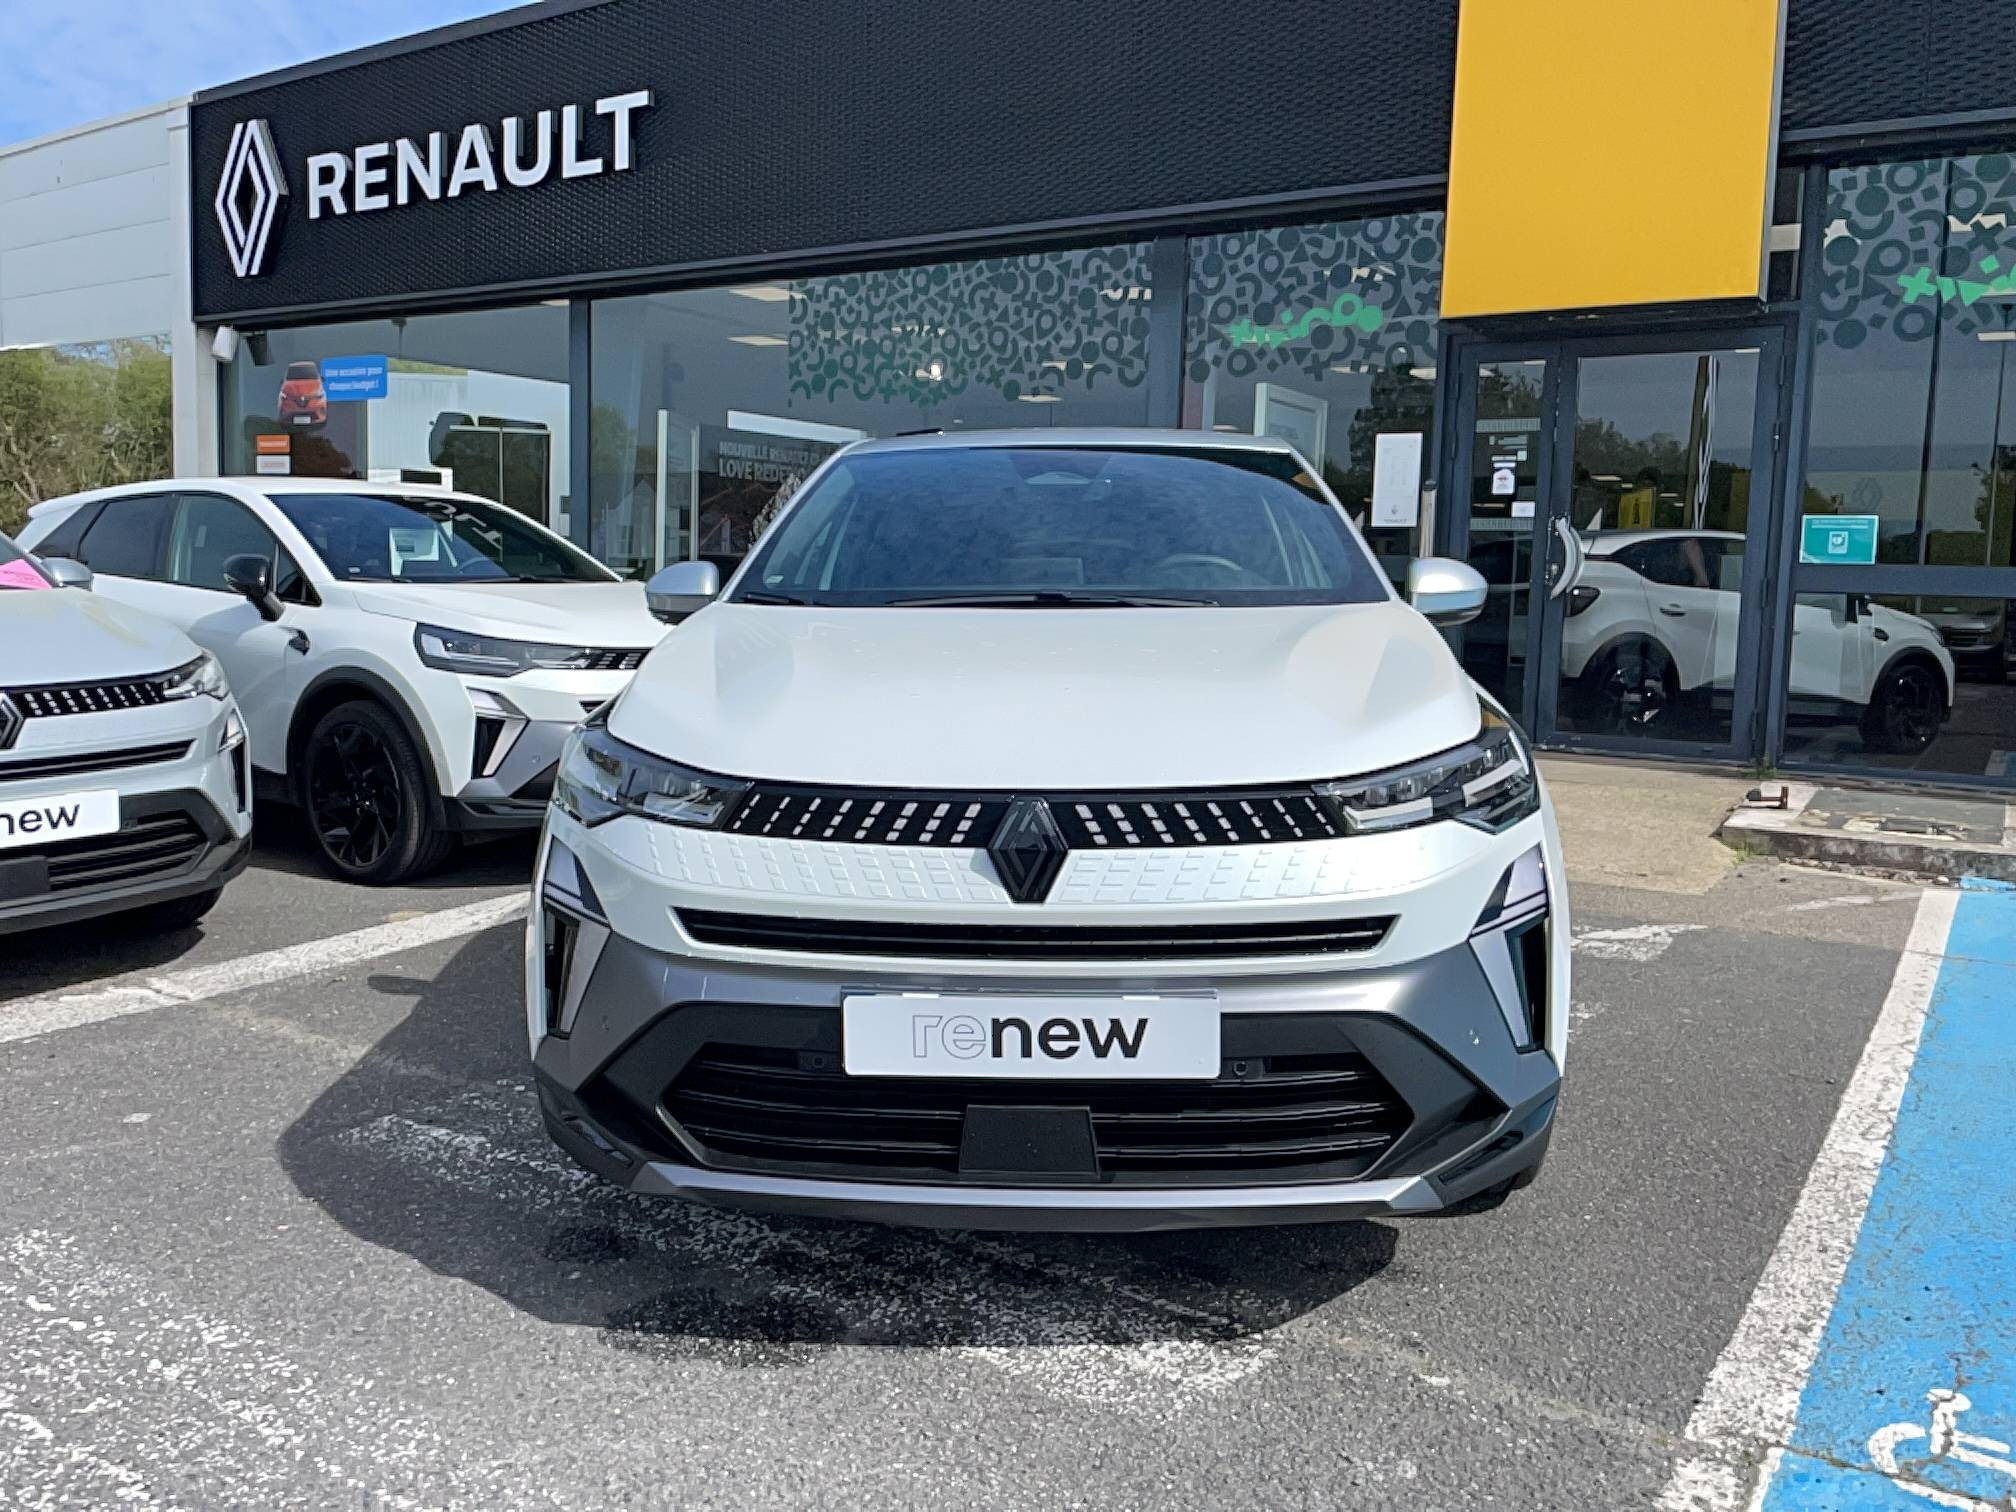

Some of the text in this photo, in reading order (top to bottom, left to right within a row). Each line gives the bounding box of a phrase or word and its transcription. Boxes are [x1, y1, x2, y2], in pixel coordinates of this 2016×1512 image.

[307, 89, 652, 220] RENAULT
[719, 458, 752, 480] LOVE
[912, 1014, 1150, 1060] renew
